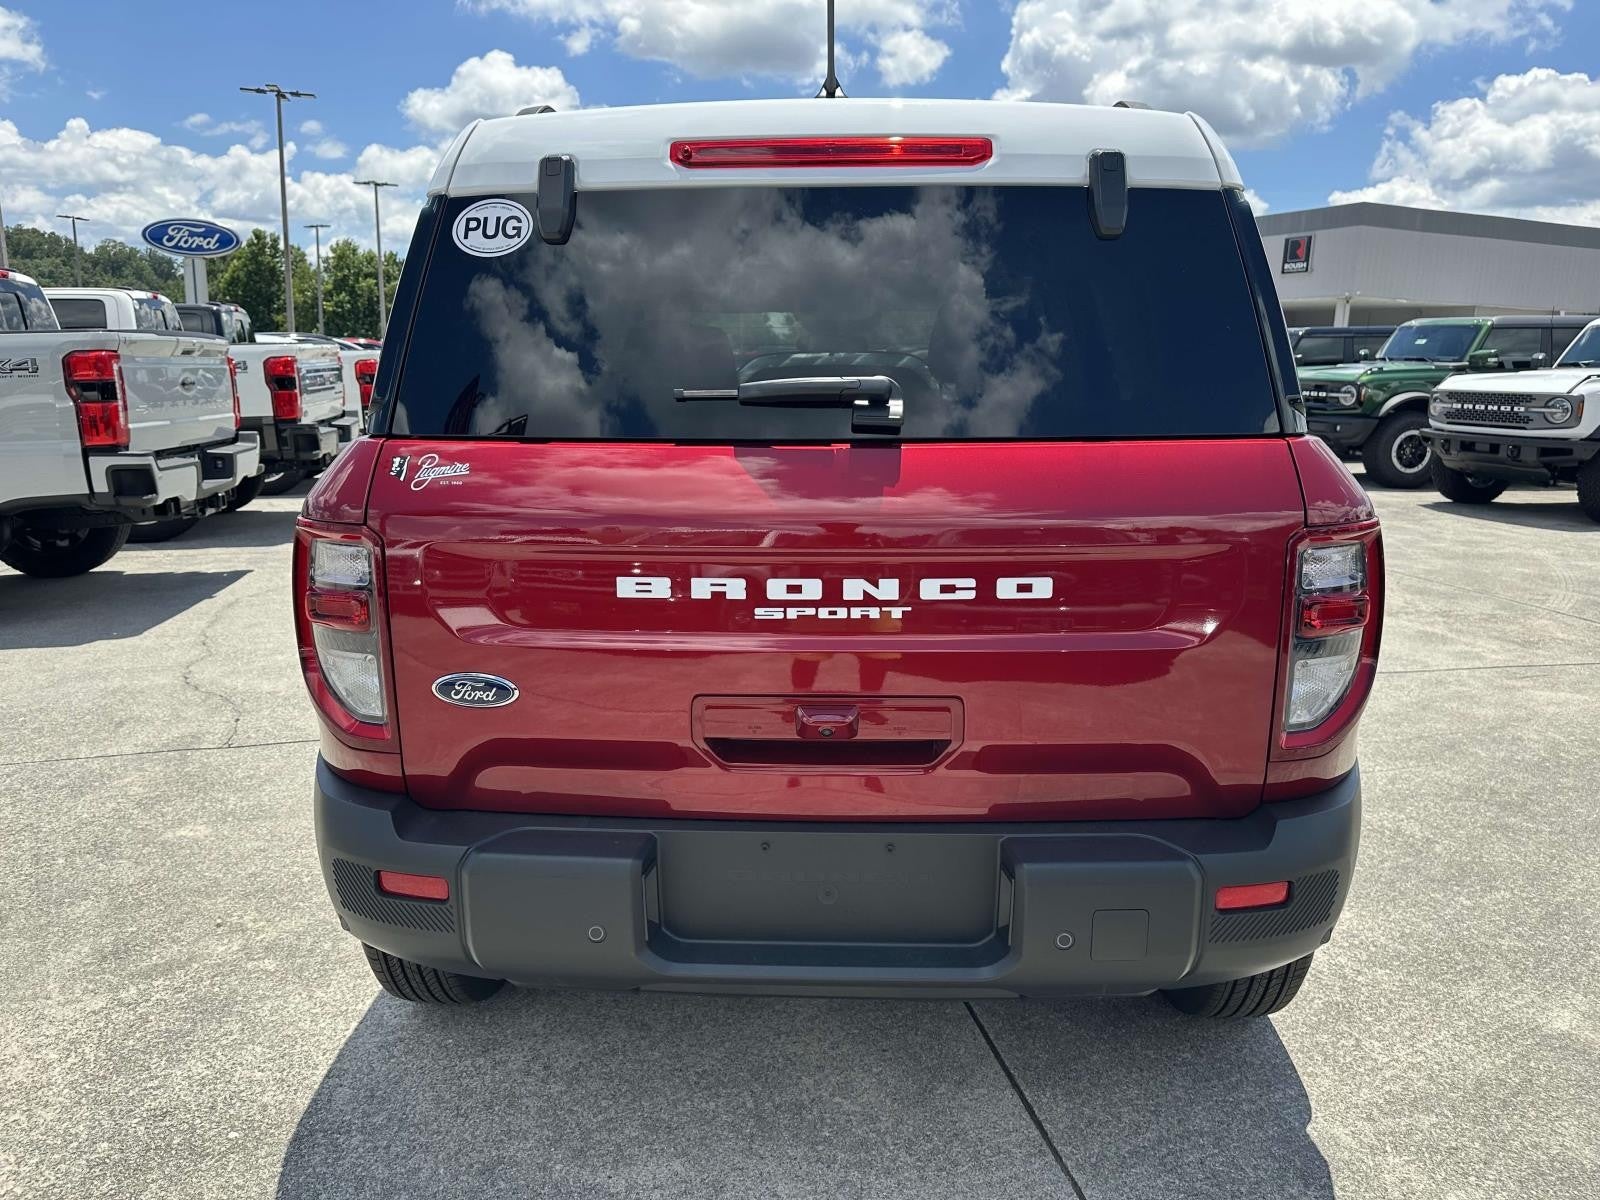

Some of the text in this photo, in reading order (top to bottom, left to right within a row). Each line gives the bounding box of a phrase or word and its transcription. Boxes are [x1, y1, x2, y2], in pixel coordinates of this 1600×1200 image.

[162, 224, 221, 250] Ford
[463, 215, 523, 240] PUG
[1452, 403, 1525, 412] BRONCO
[410, 453, 470, 491] Pugmire
[616, 576, 1054, 601] BRONCO
[753, 607, 913, 620] SPORT
[450, 680, 497, 701] Ford
